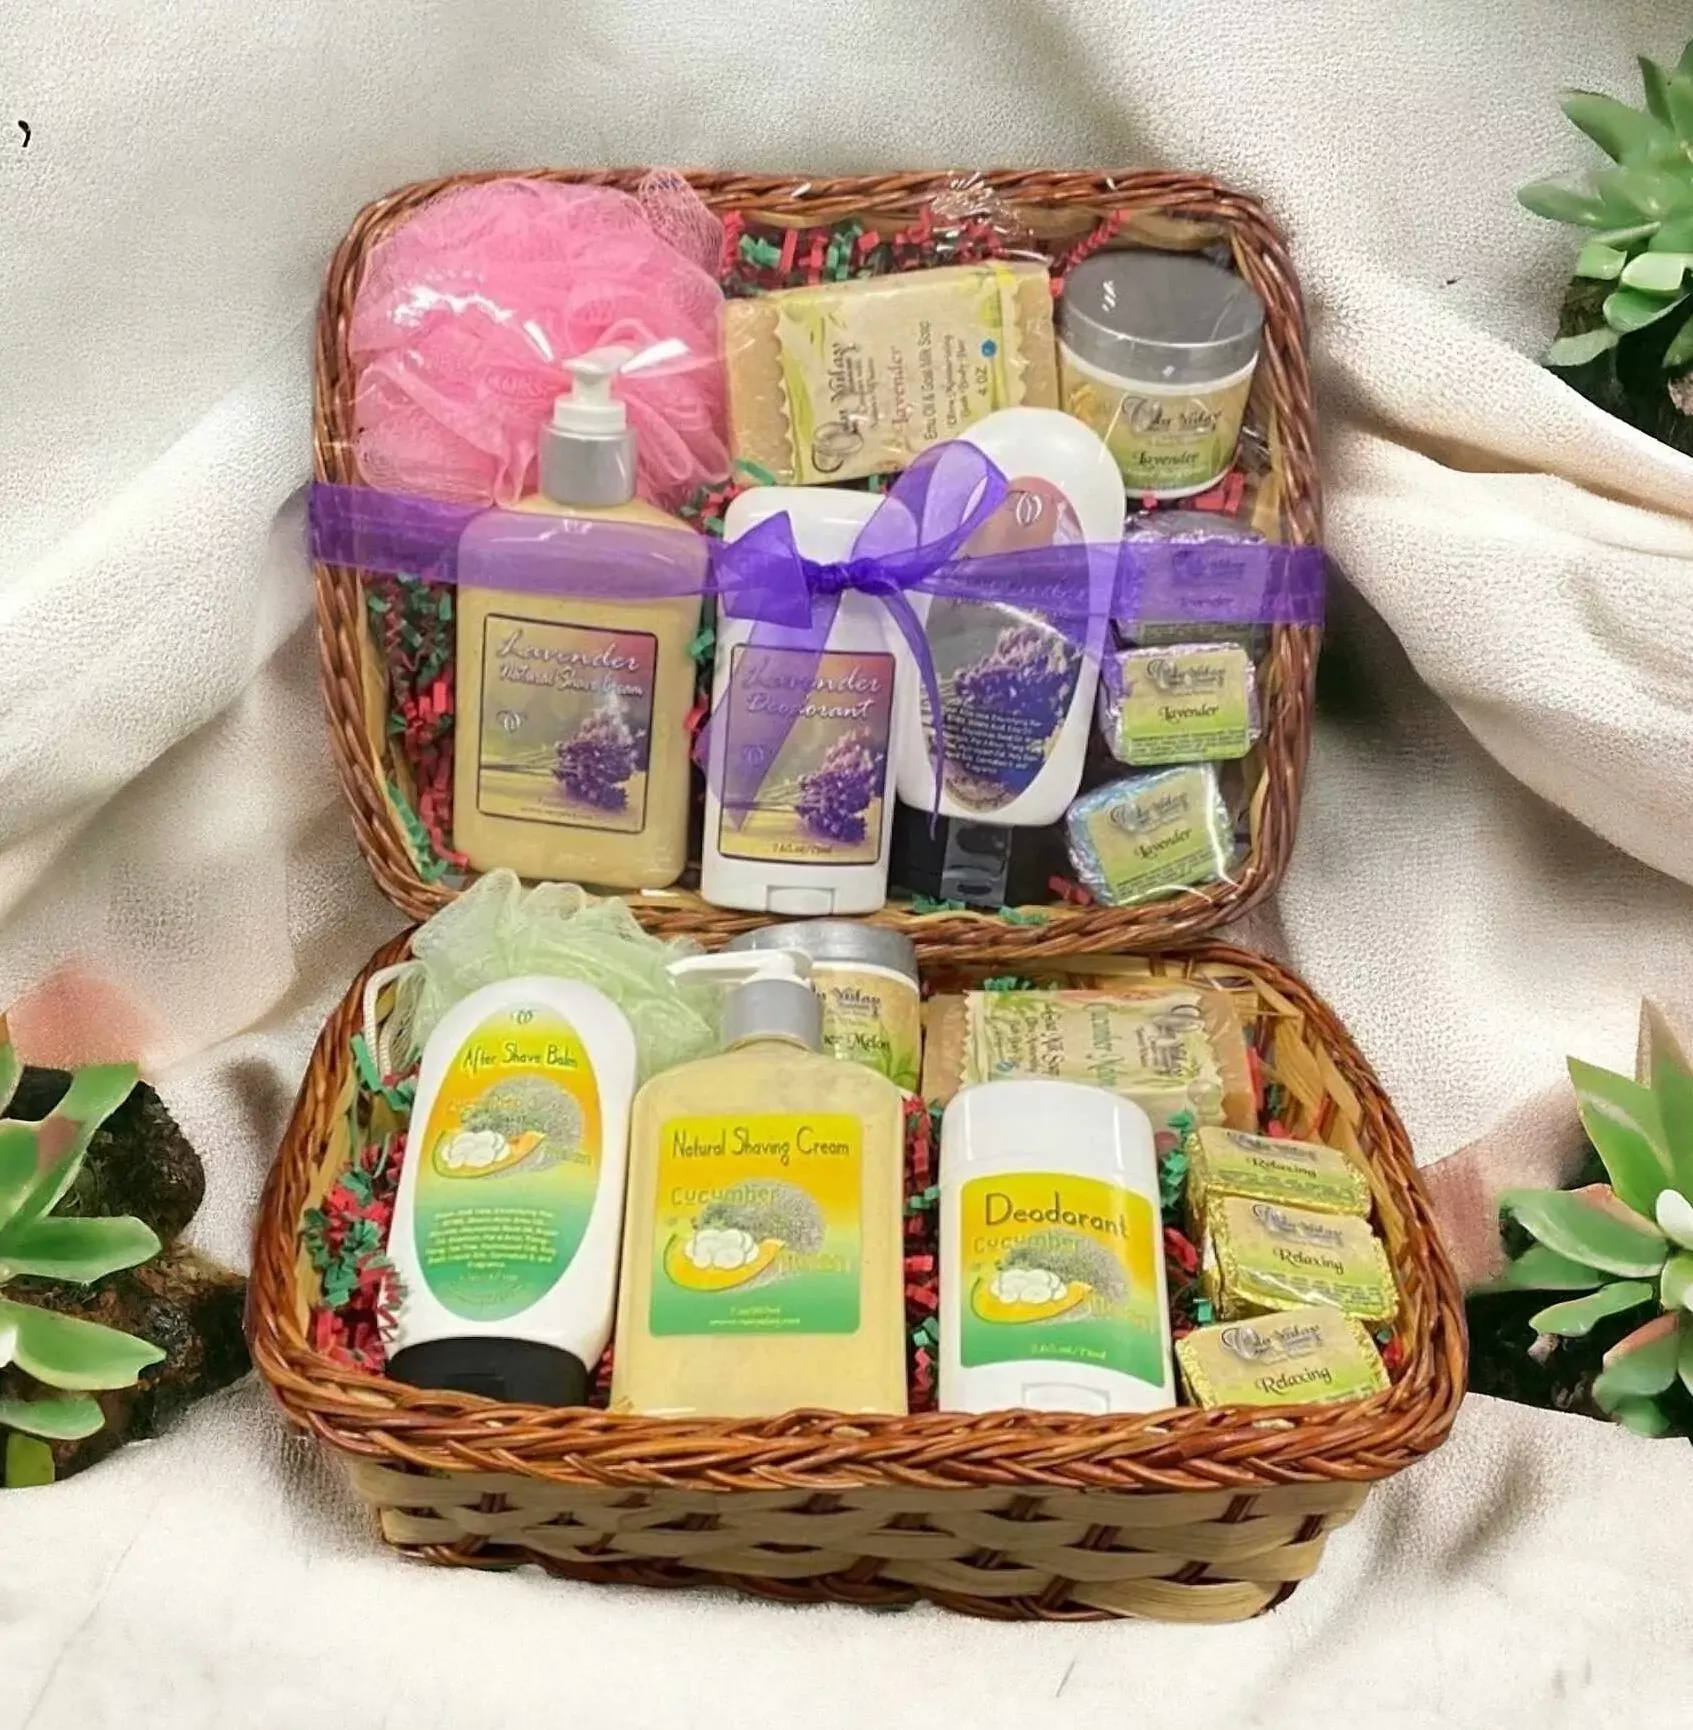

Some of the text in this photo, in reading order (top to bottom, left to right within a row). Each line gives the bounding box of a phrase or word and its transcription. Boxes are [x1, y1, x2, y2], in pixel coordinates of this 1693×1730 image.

[974, 365, 987, 385] OZ
[496, 627, 640, 671] Lavender
[741, 655, 883, 694] Lavender
[746, 690, 875, 721] Deodorant
[1158, 703, 1220, 725] Lavender
[1134, 827, 1192, 859] Lavender
[462, 1041, 578, 1076] After Shave Balm
[672, 1126, 850, 1166] Natural Shaving Cream
[985, 1190, 1129, 1239] Deodorant
[1273, 1248, 1345, 1275] Relaxing
[1255, 1366, 1333, 1395] Relaxing
